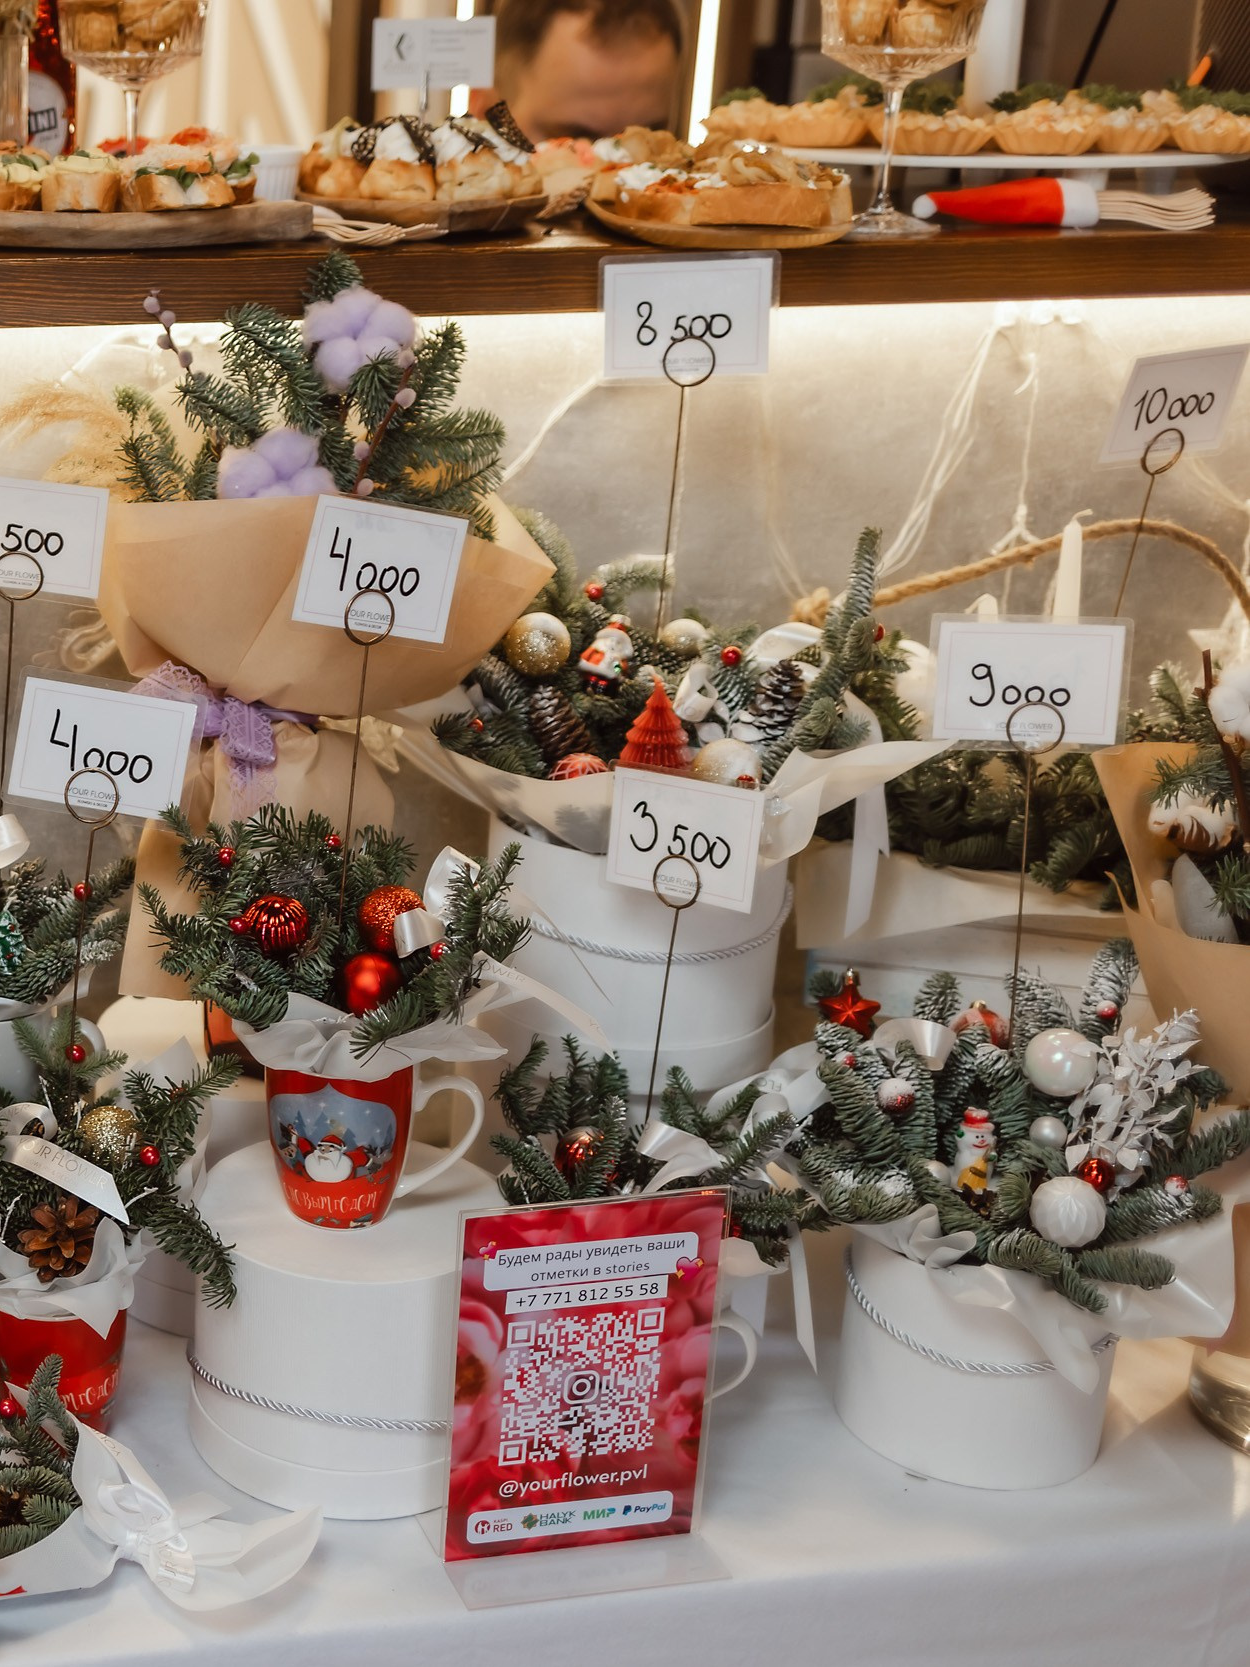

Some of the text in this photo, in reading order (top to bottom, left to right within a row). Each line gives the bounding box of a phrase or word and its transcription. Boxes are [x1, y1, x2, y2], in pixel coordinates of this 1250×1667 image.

[636, 301, 732, 346] 8 500
[1134, 387, 1215, 431] 10 000
[0, 523, 64, 556] 500
[329, 526, 420, 597] 4 000
[15, 571, 42, 580] FLOWE
[348, 609, 392, 622] OUR FLOWE
[969, 663, 1071, 706] 9 000
[50, 708, 153, 784] 4 000
[630, 801, 731, 869] 3 500
[498, 1238, 685, 1267] Будем рады увидеть ваши
[531, 1260, 650, 1282] отметки в stories
[515, 1282, 659, 1307] +7 771 812 55 58
[498, 1464, 648, 1498] @yourflower.pvl
[539, 1510, 576, 1520] HALYK
[539, 1517, 572, 1527] BANK
[583, 1507, 617, 1521] МИР
[634, 1502, 667, 1515] PayPal
[493, 1523, 513, 1532] RED
